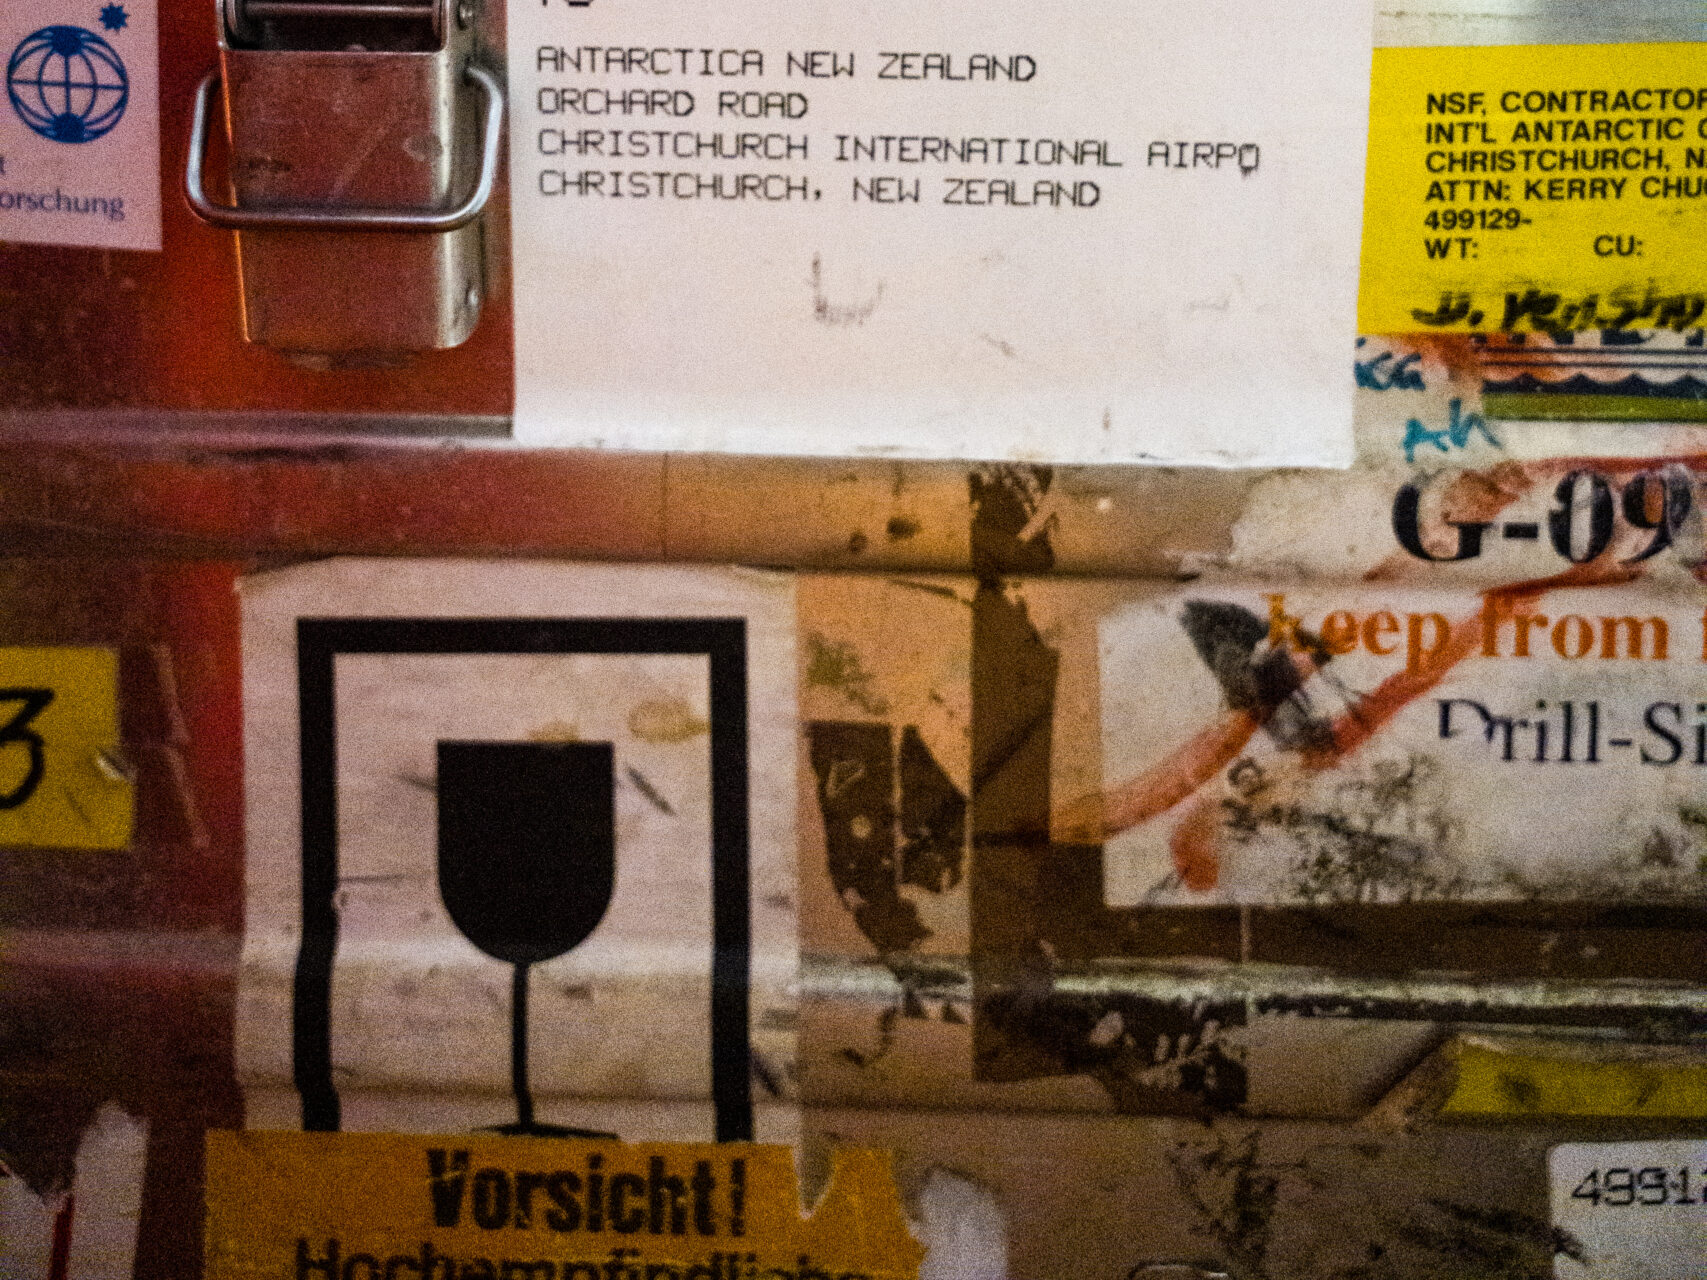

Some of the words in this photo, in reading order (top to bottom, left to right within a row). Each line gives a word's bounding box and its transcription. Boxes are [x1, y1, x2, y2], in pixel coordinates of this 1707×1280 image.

[536, 45, 764, 77] ANTARCTICA
[786, 50, 855, 79] NEW
[877, 51, 1038, 83] ZEALAND
[536, 86, 696, 118] ORCHARD
[717, 90, 809, 120] ROAD
[1426, 91, 1487, 116] NSF,
[1425, 121, 1497, 145] INT'L
[1511, 116, 1685, 143] ANTARCTIC
[537, 127, 809, 161] CHRISTCHURCH
[835, 134, 1123, 168] INTERNATIONAL
[1425, 146, 1671, 174] CHRISTCHURCH,
[537, 168, 823, 202] CHRISTCHURCH,
[852, 176, 921, 204] NEW
[942, 177, 1102, 209] ZEALAND
[1425, 179, 1511, 202] ATTN:
[1524, 177, 1628, 201] KERRY
[1640, 175, 1707, 199] CHU
[1424, 207, 1533, 231] 499129-
[1424, 237, 1478, 260] WT:
[1593, 234, 1643, 259] CU:
[426, 1148, 746, 1239] Vorsicht!
